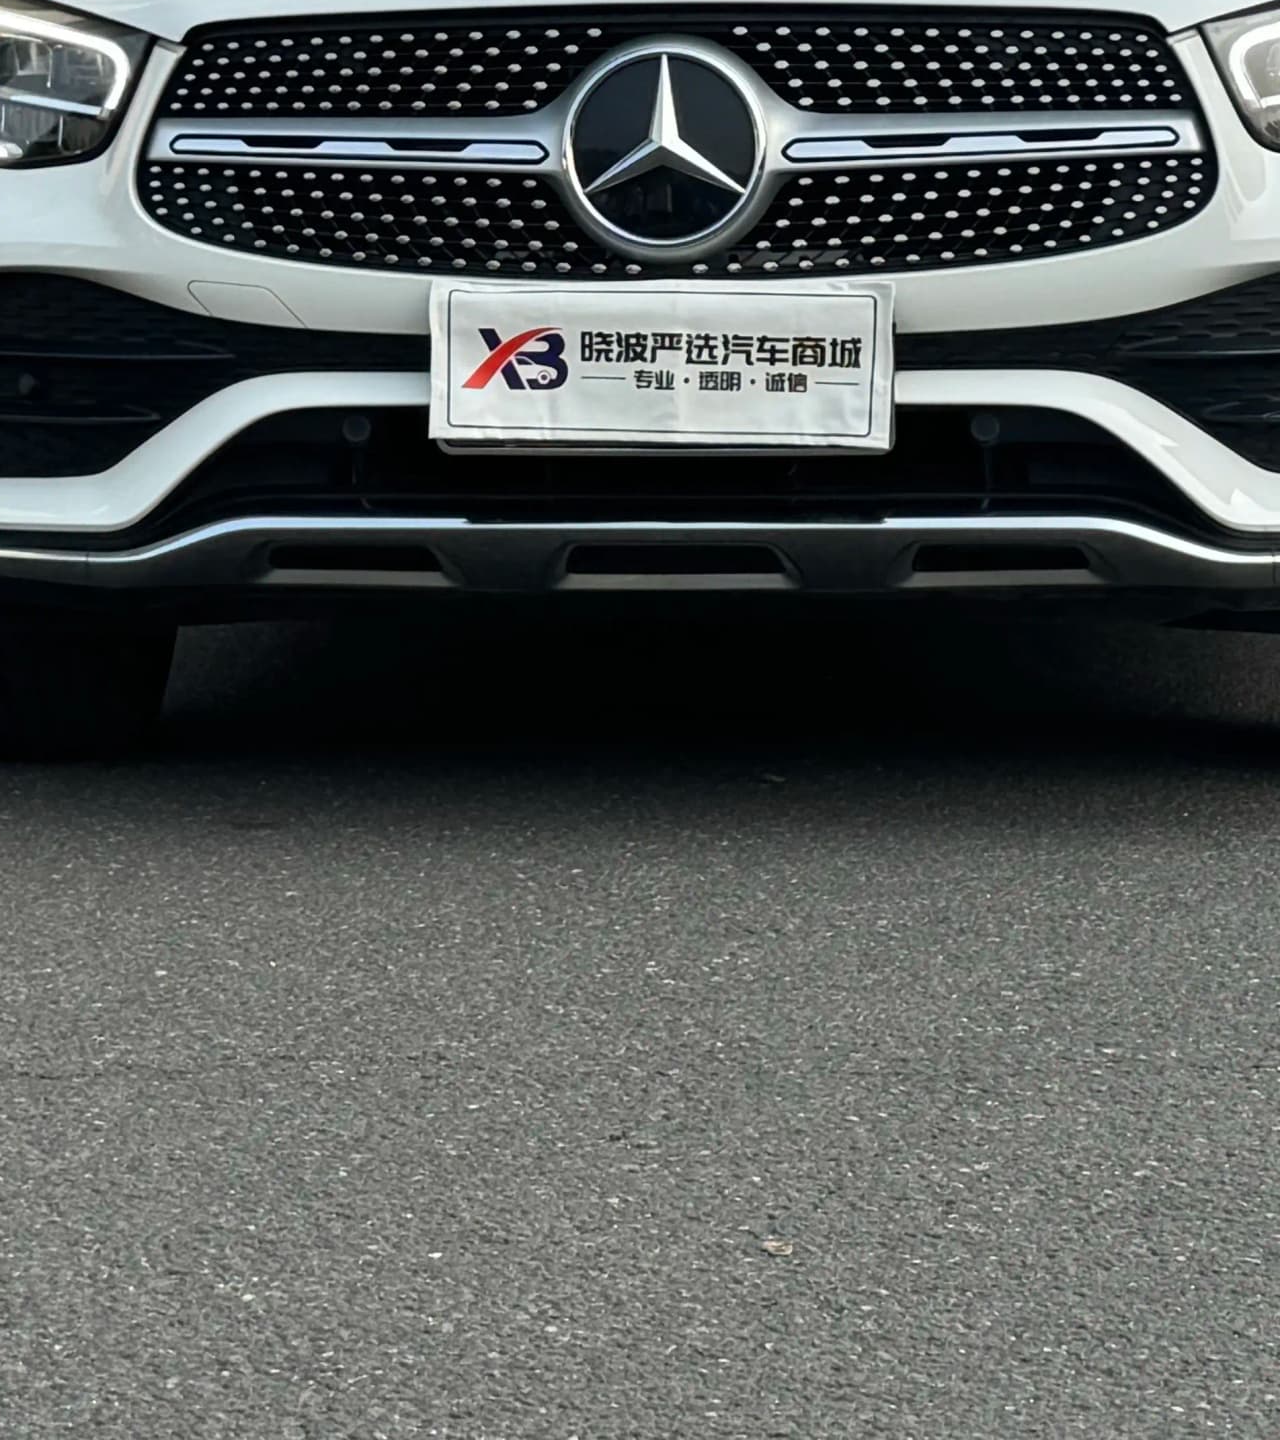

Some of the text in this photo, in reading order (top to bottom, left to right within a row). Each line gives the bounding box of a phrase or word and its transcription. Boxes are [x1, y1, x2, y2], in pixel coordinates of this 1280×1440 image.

[580, 331, 862, 369] 晓波严选汽车商城
